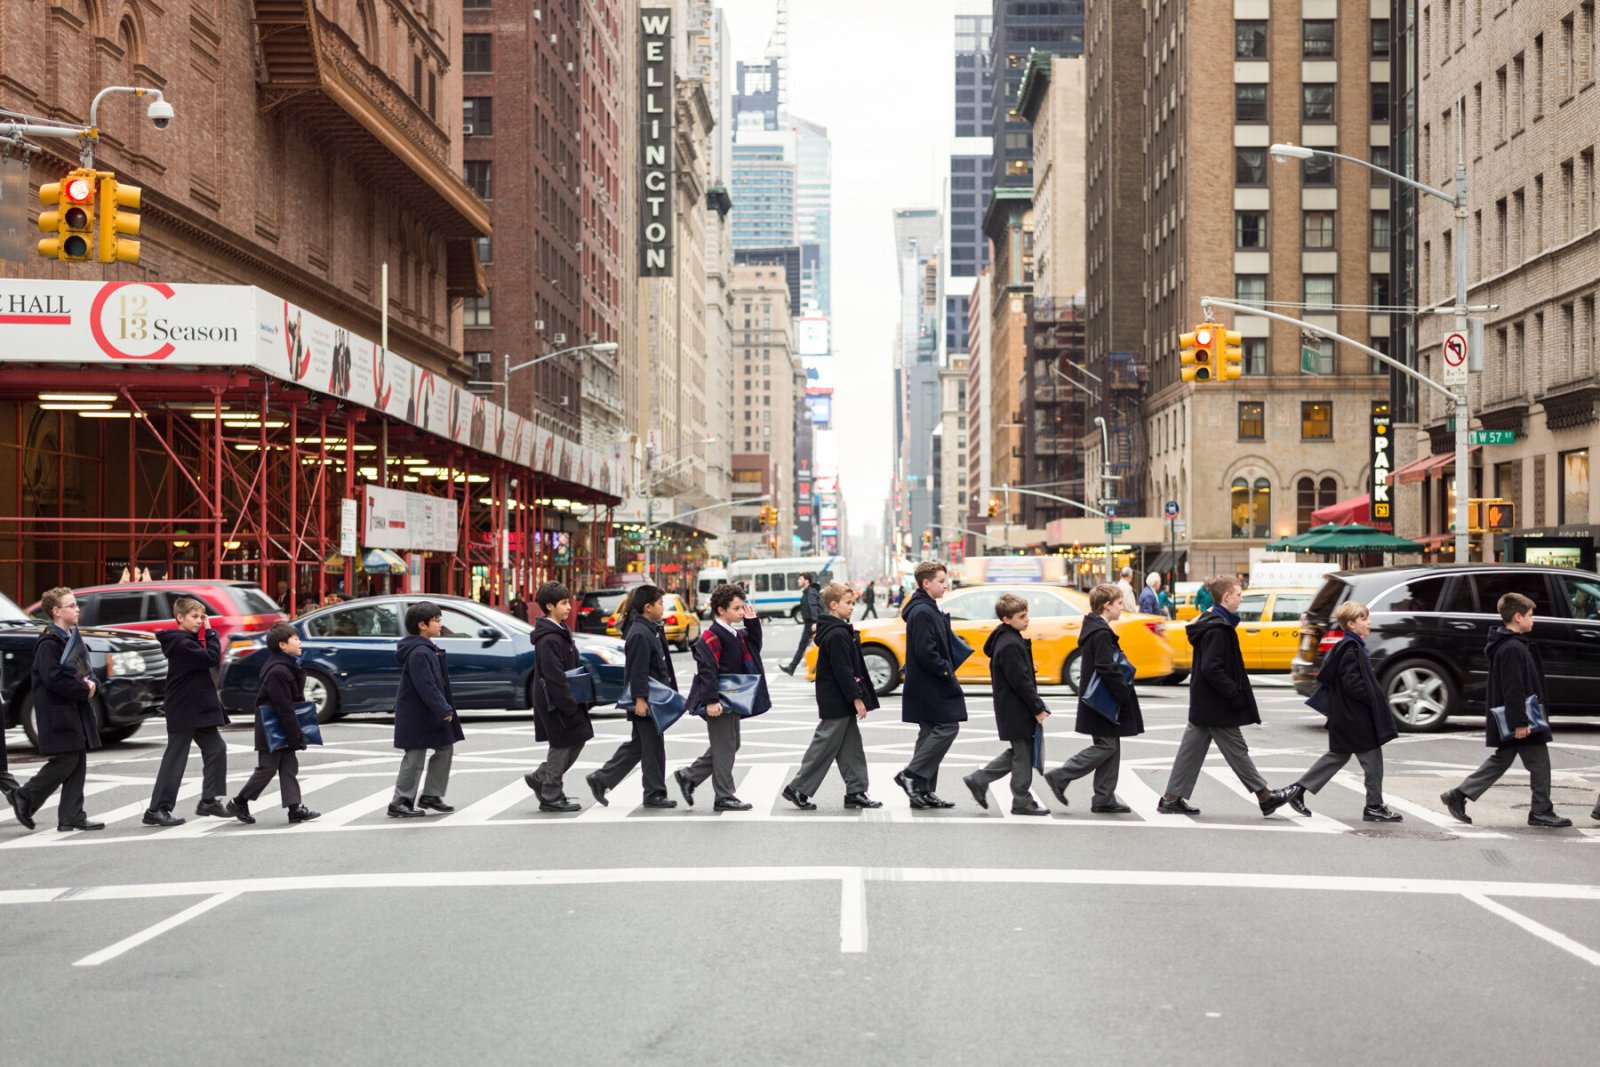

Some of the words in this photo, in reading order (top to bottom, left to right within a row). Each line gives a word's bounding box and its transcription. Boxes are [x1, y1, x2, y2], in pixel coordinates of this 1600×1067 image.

[641, 15, 669, 268] WELLINGTON
[8, 294, 71, 314] HALL
[119, 294, 148, 317] 12
[119, 317, 148, 341] 13
[153, 318, 238, 342] Season
[1478, 432, 1487, 443] W
[1489, 432, 1502, 443] 57
[1374, 436, 1390, 502] PARK
